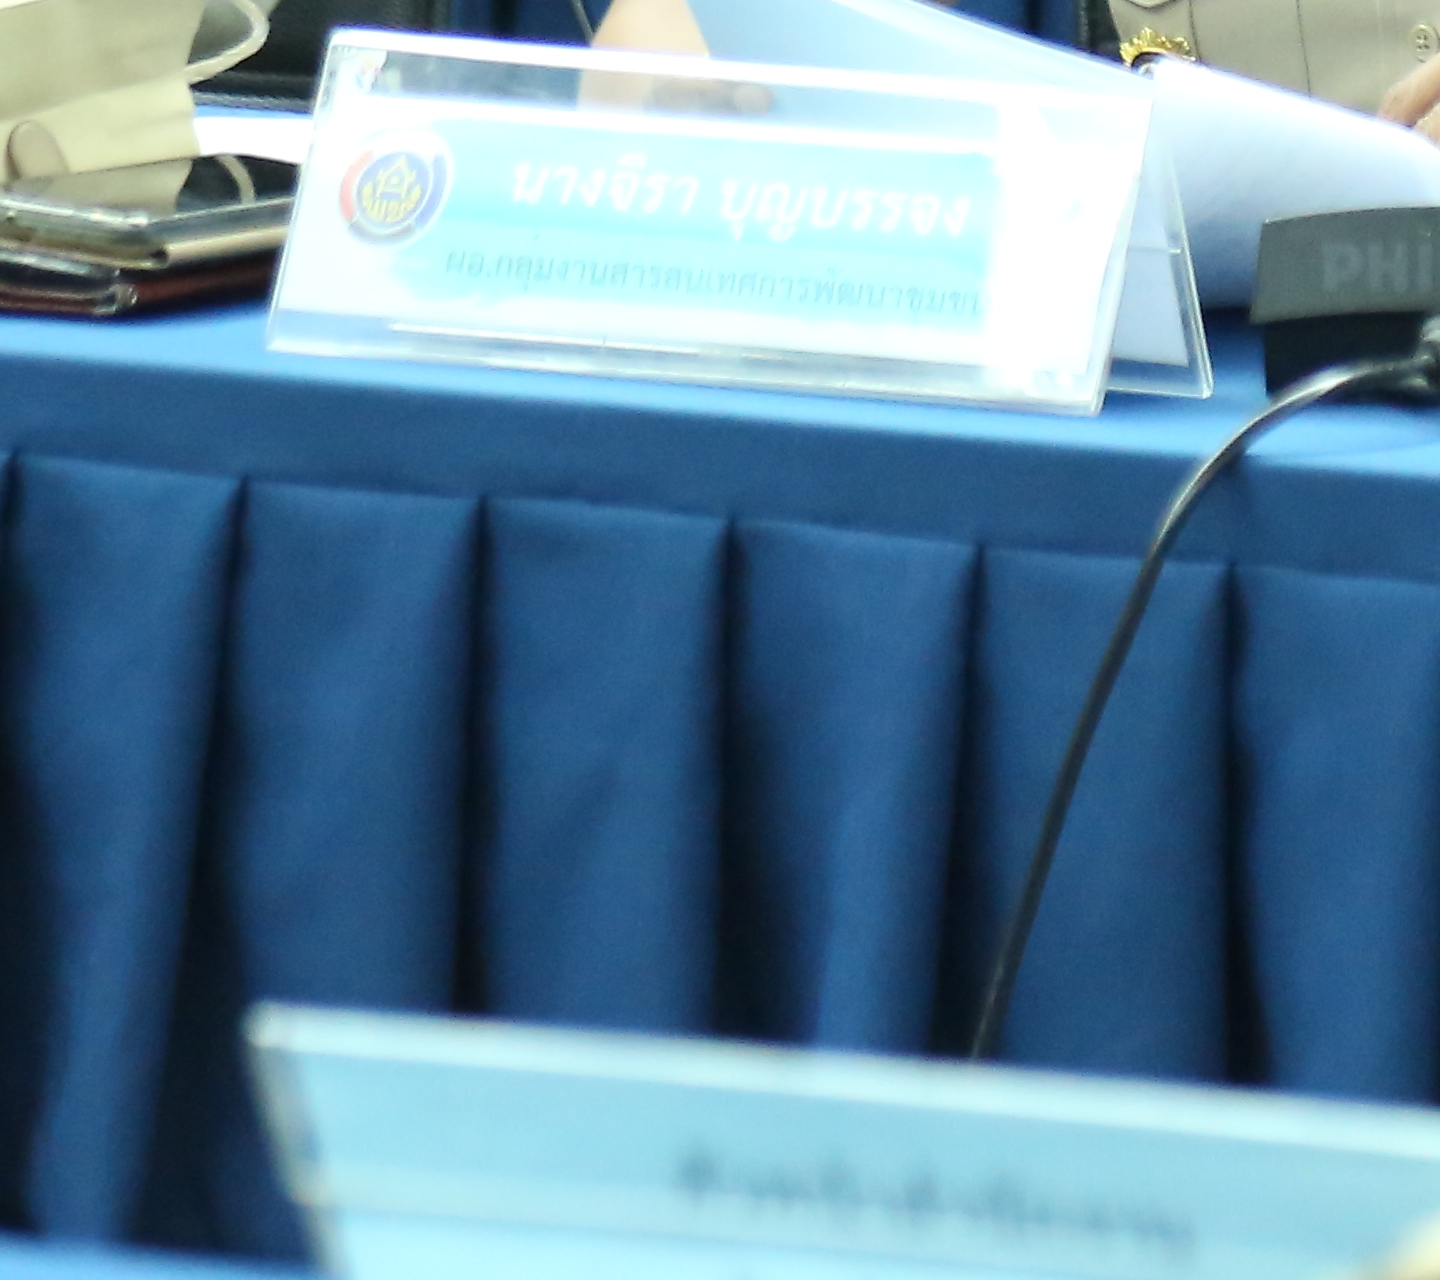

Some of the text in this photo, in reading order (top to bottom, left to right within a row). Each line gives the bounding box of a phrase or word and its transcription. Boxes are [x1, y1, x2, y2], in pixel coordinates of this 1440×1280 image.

[511, 151, 971, 241] นางจิรา บุญบรรจง
